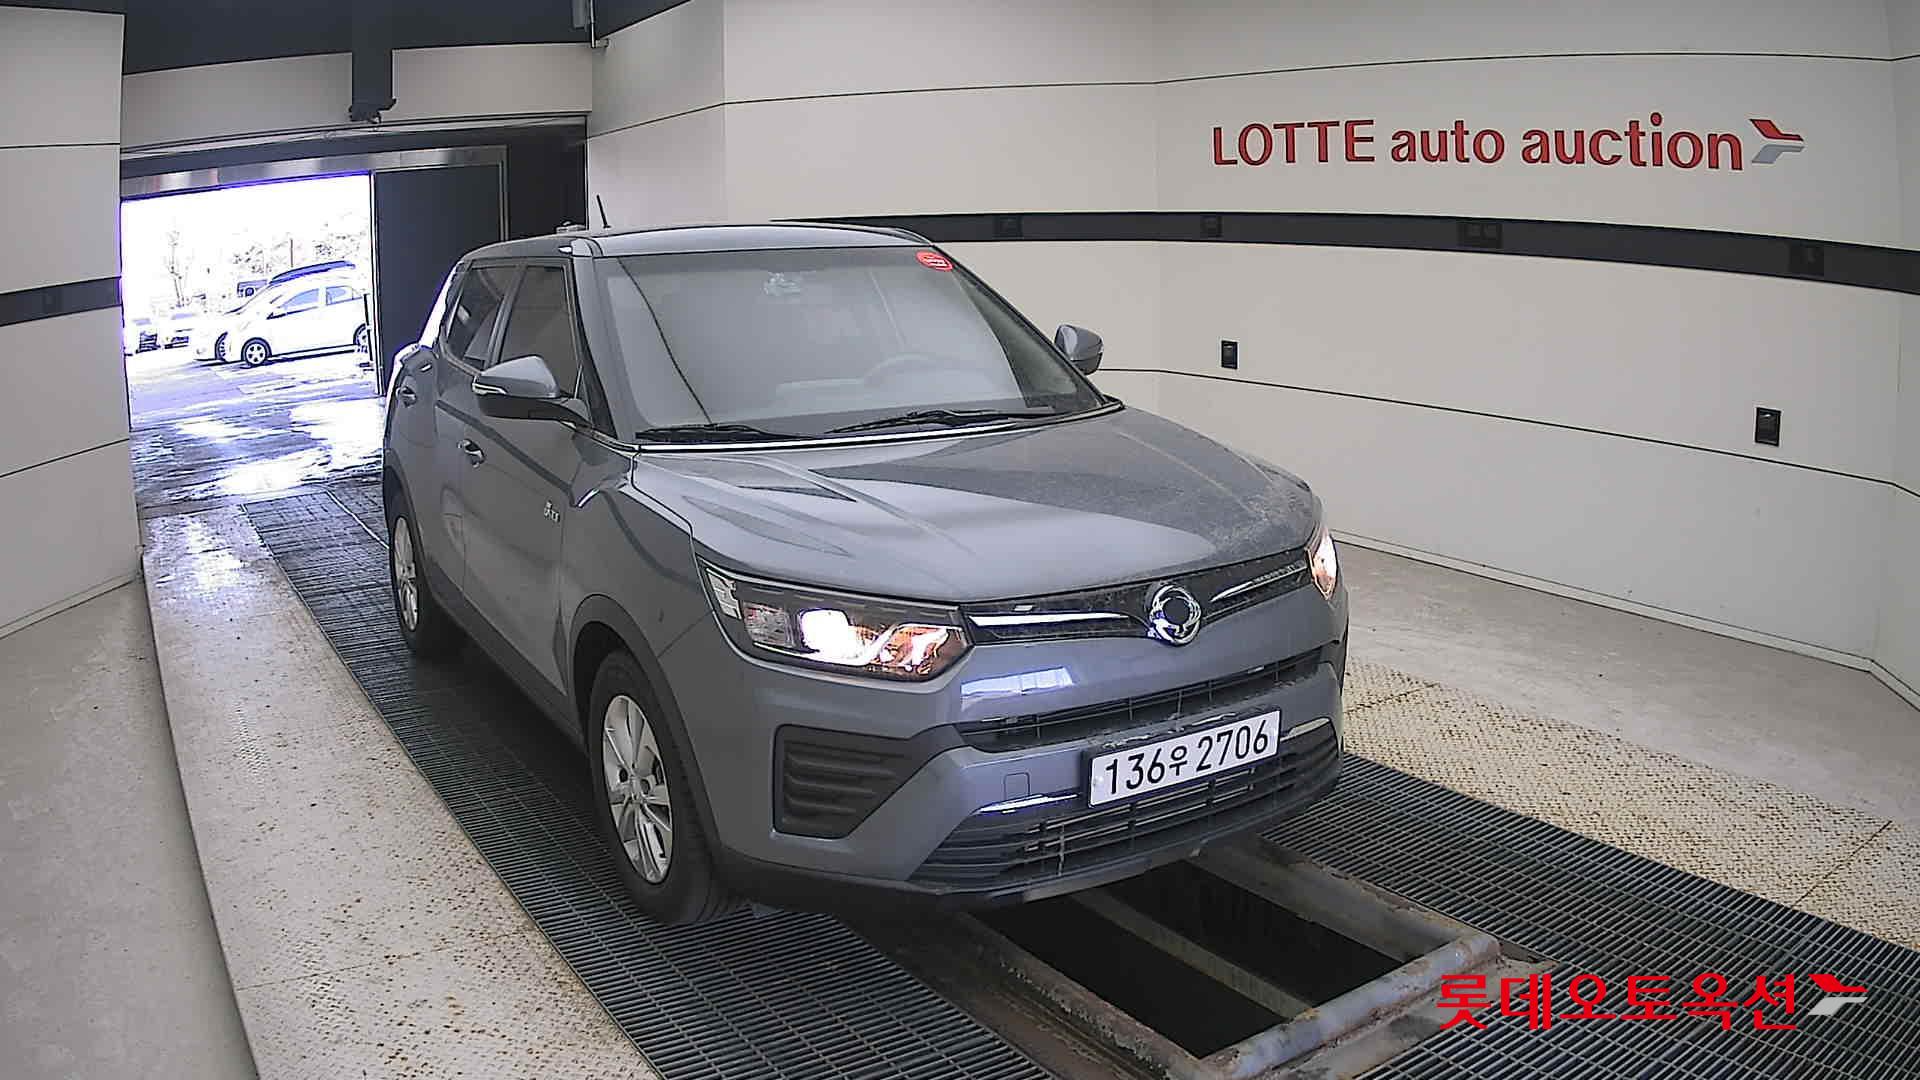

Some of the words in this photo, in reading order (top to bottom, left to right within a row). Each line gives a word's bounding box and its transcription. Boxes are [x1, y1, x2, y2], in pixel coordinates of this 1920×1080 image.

[1212, 119, 1376, 166] LOTTE
[1391, 120, 1503, 163] auto
[1521, 112, 1743, 170] auction
[1106, 746, 1188, 794] 136우
[1196, 719, 1268, 772] 2706
